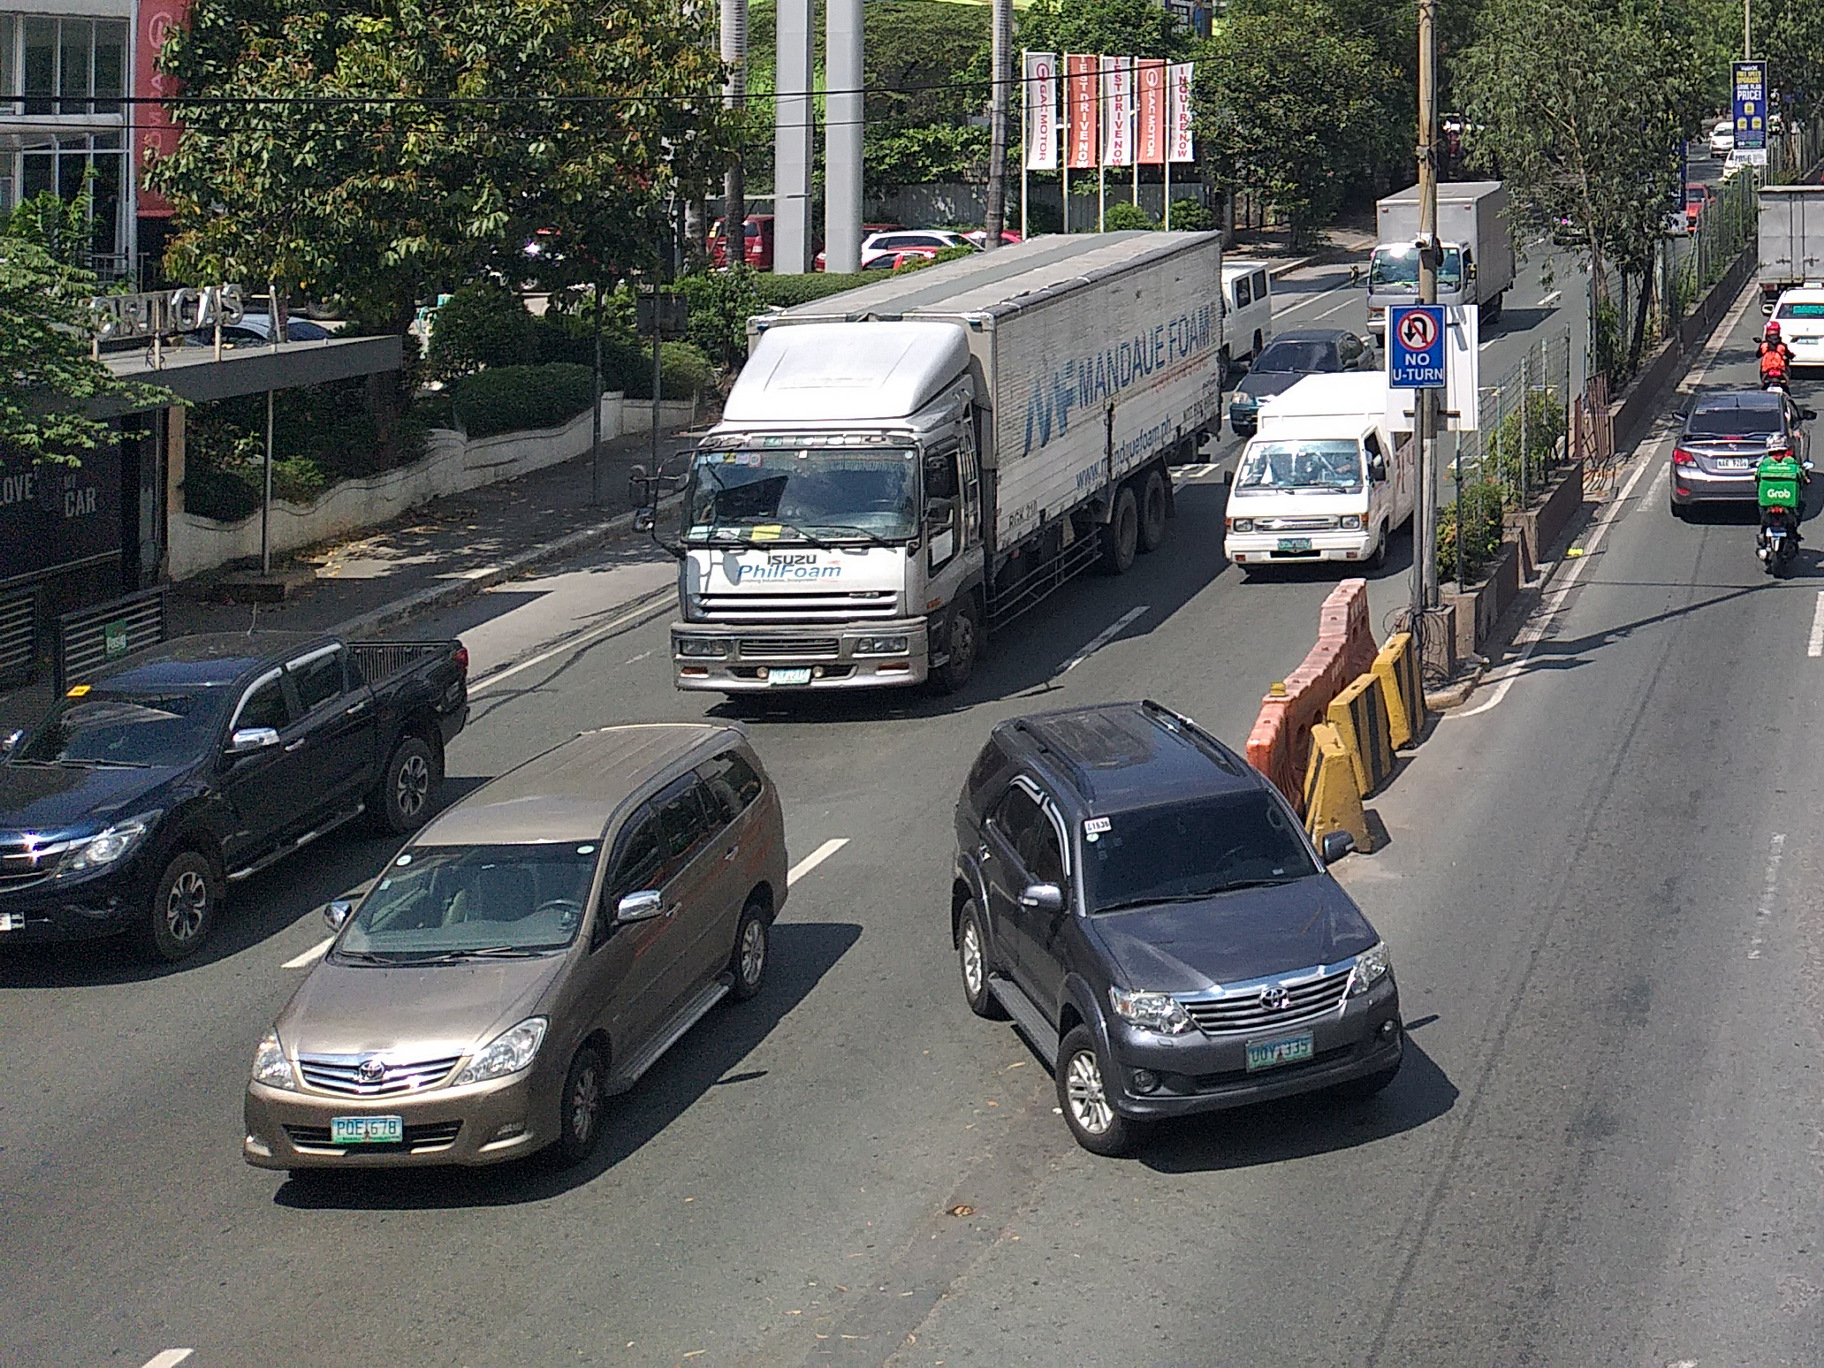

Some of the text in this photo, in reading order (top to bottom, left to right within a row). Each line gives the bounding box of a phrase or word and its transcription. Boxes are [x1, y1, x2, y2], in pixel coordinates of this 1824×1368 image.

[1114, 95, 1123, 139] DRIVE
[1039, 116, 1048, 161] MOTOR
[1078, 324, 1165, 410] MANDAUE
[1168, 304, 1211, 363] FOAM
[1405, 353, 1430, 366] NO
[1393, 368, 1443, 381] U-TURN
[0, 472, 34, 505] OVE
[1767, 489, 1791, 498] Grab
[737, 564, 842, 579] PhilFoam
[370, 1120, 396, 1135] 678
